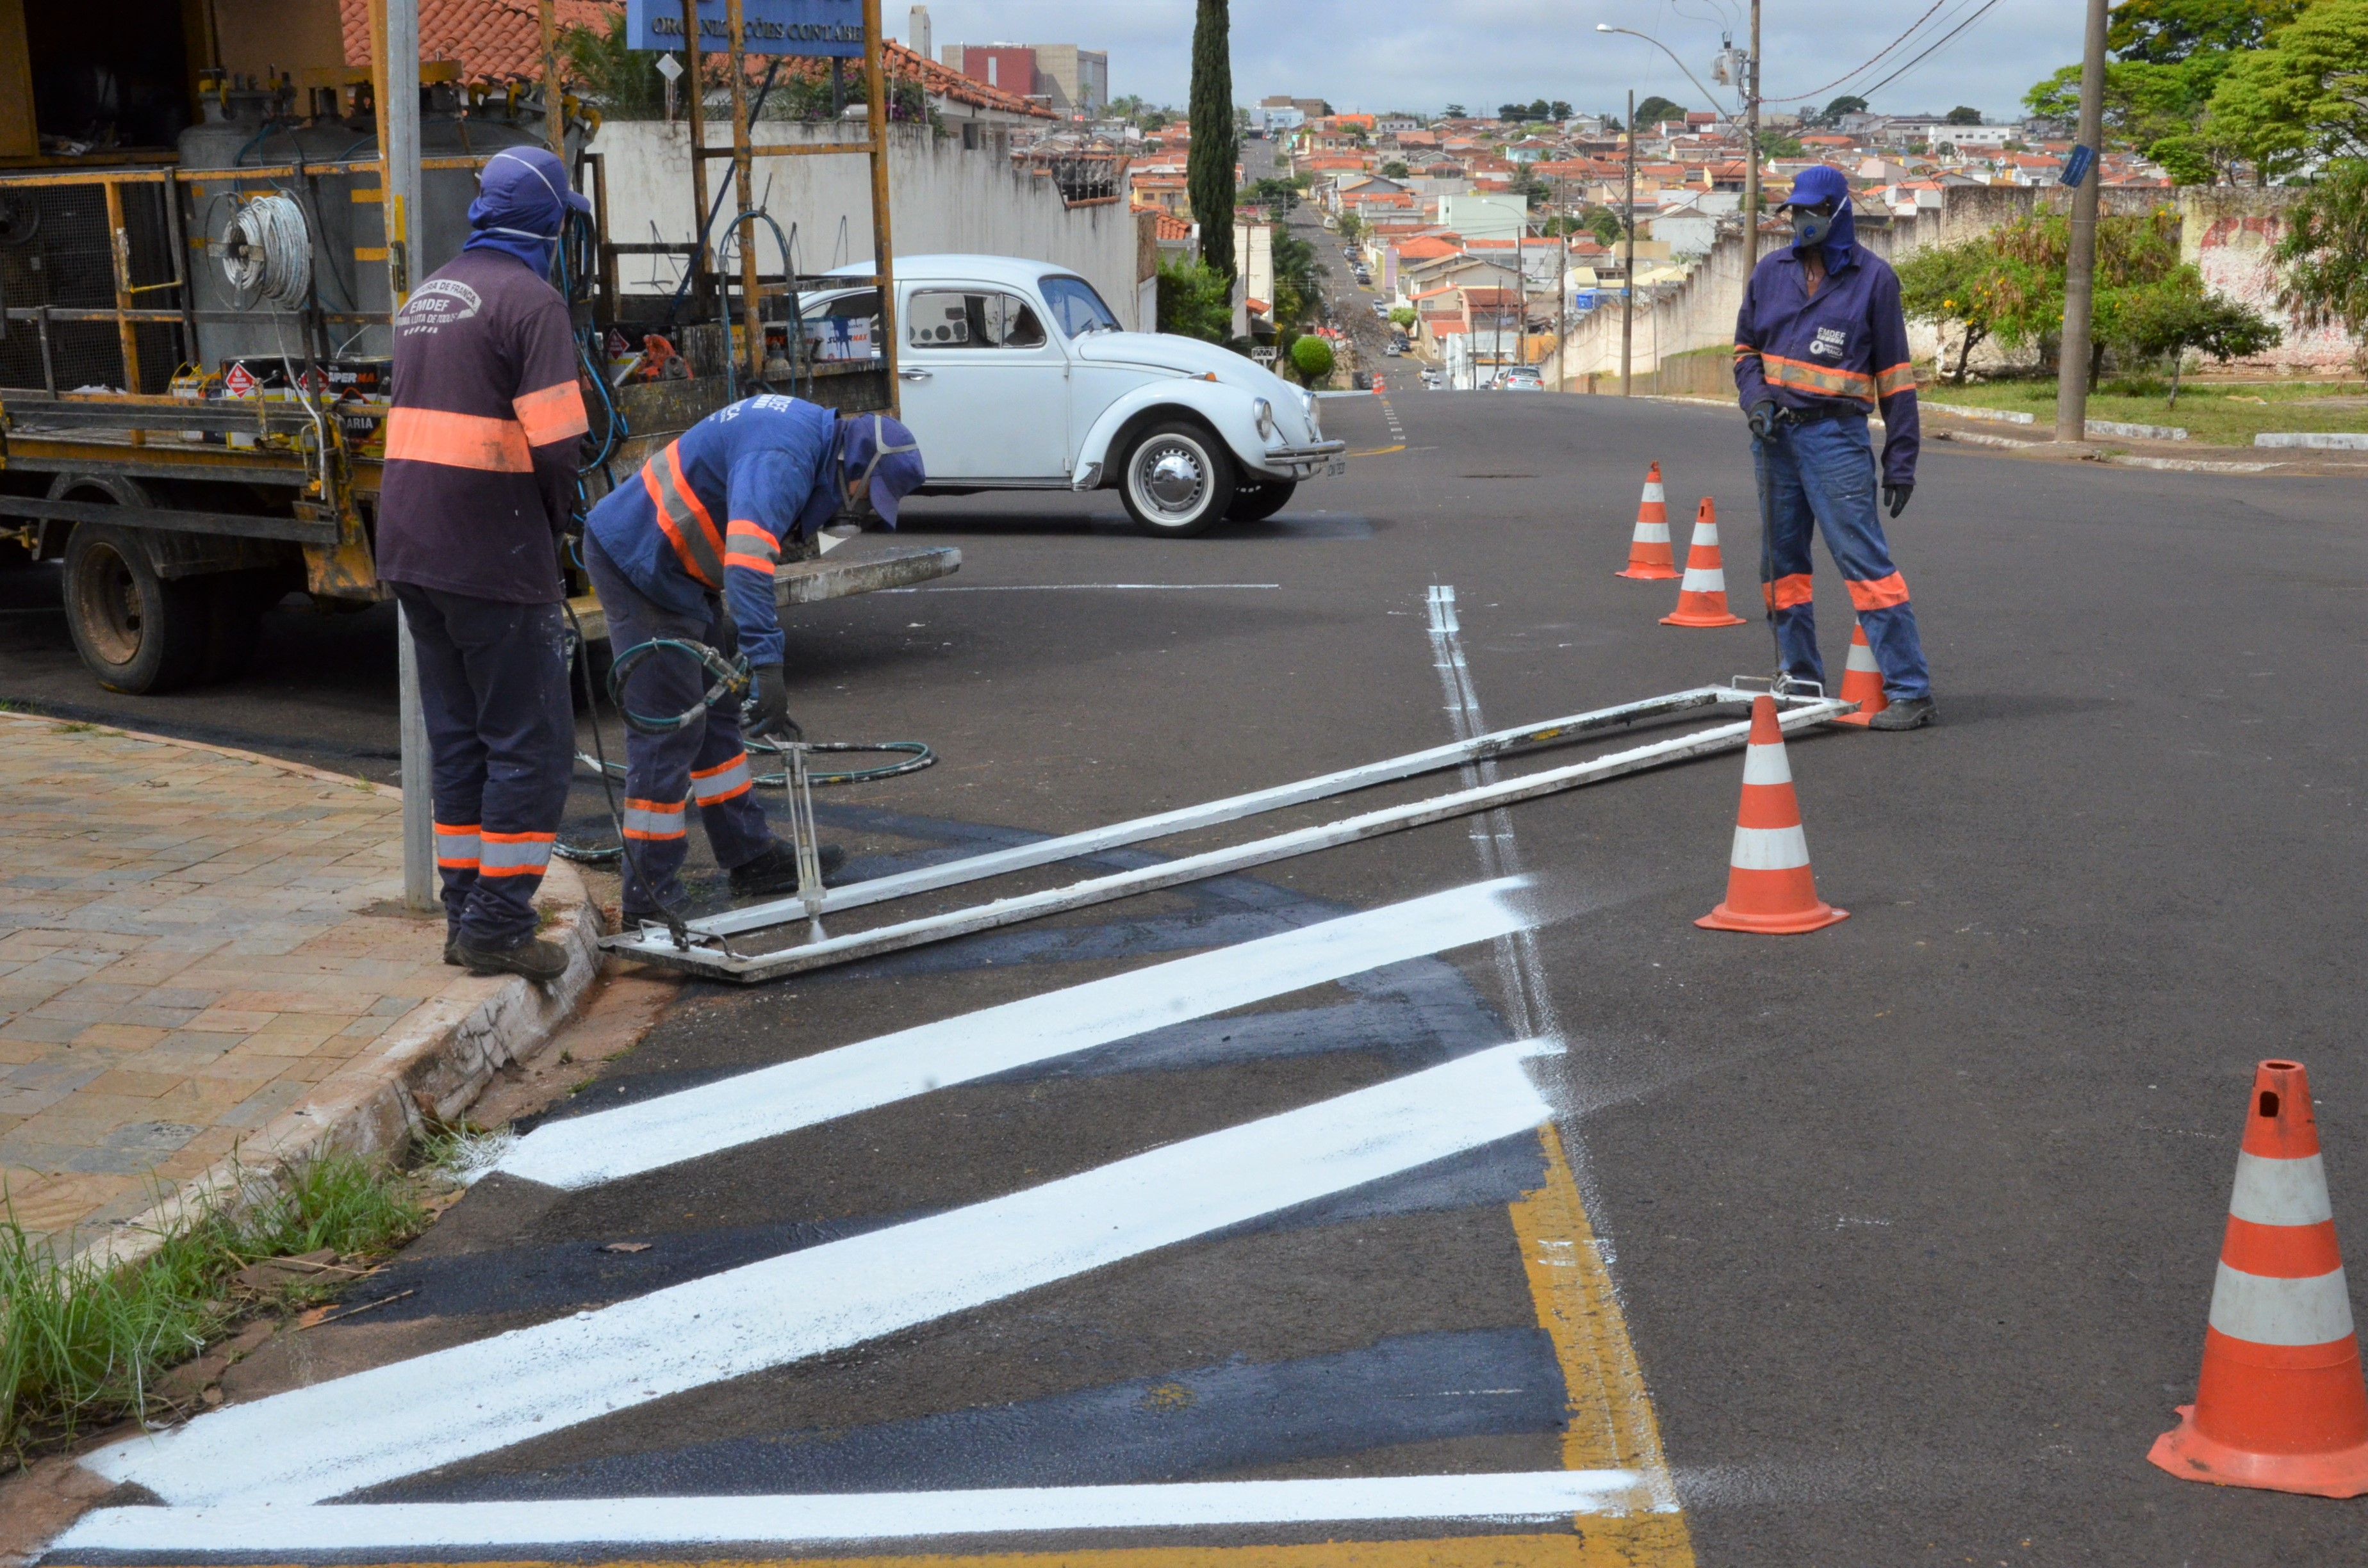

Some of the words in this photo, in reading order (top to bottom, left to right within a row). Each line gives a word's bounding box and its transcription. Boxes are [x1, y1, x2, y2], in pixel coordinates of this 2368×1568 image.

[787, 19, 865, 42] CONTÁBE
[440, 282, 450, 291] DE
[450, 284, 476, 306] FRANCA
[409, 298, 450, 314] EMDEF
[427, 314, 437, 323] DE
[1818, 327, 1845, 339] EMDEF
[347, 417, 374, 429] ARIA
